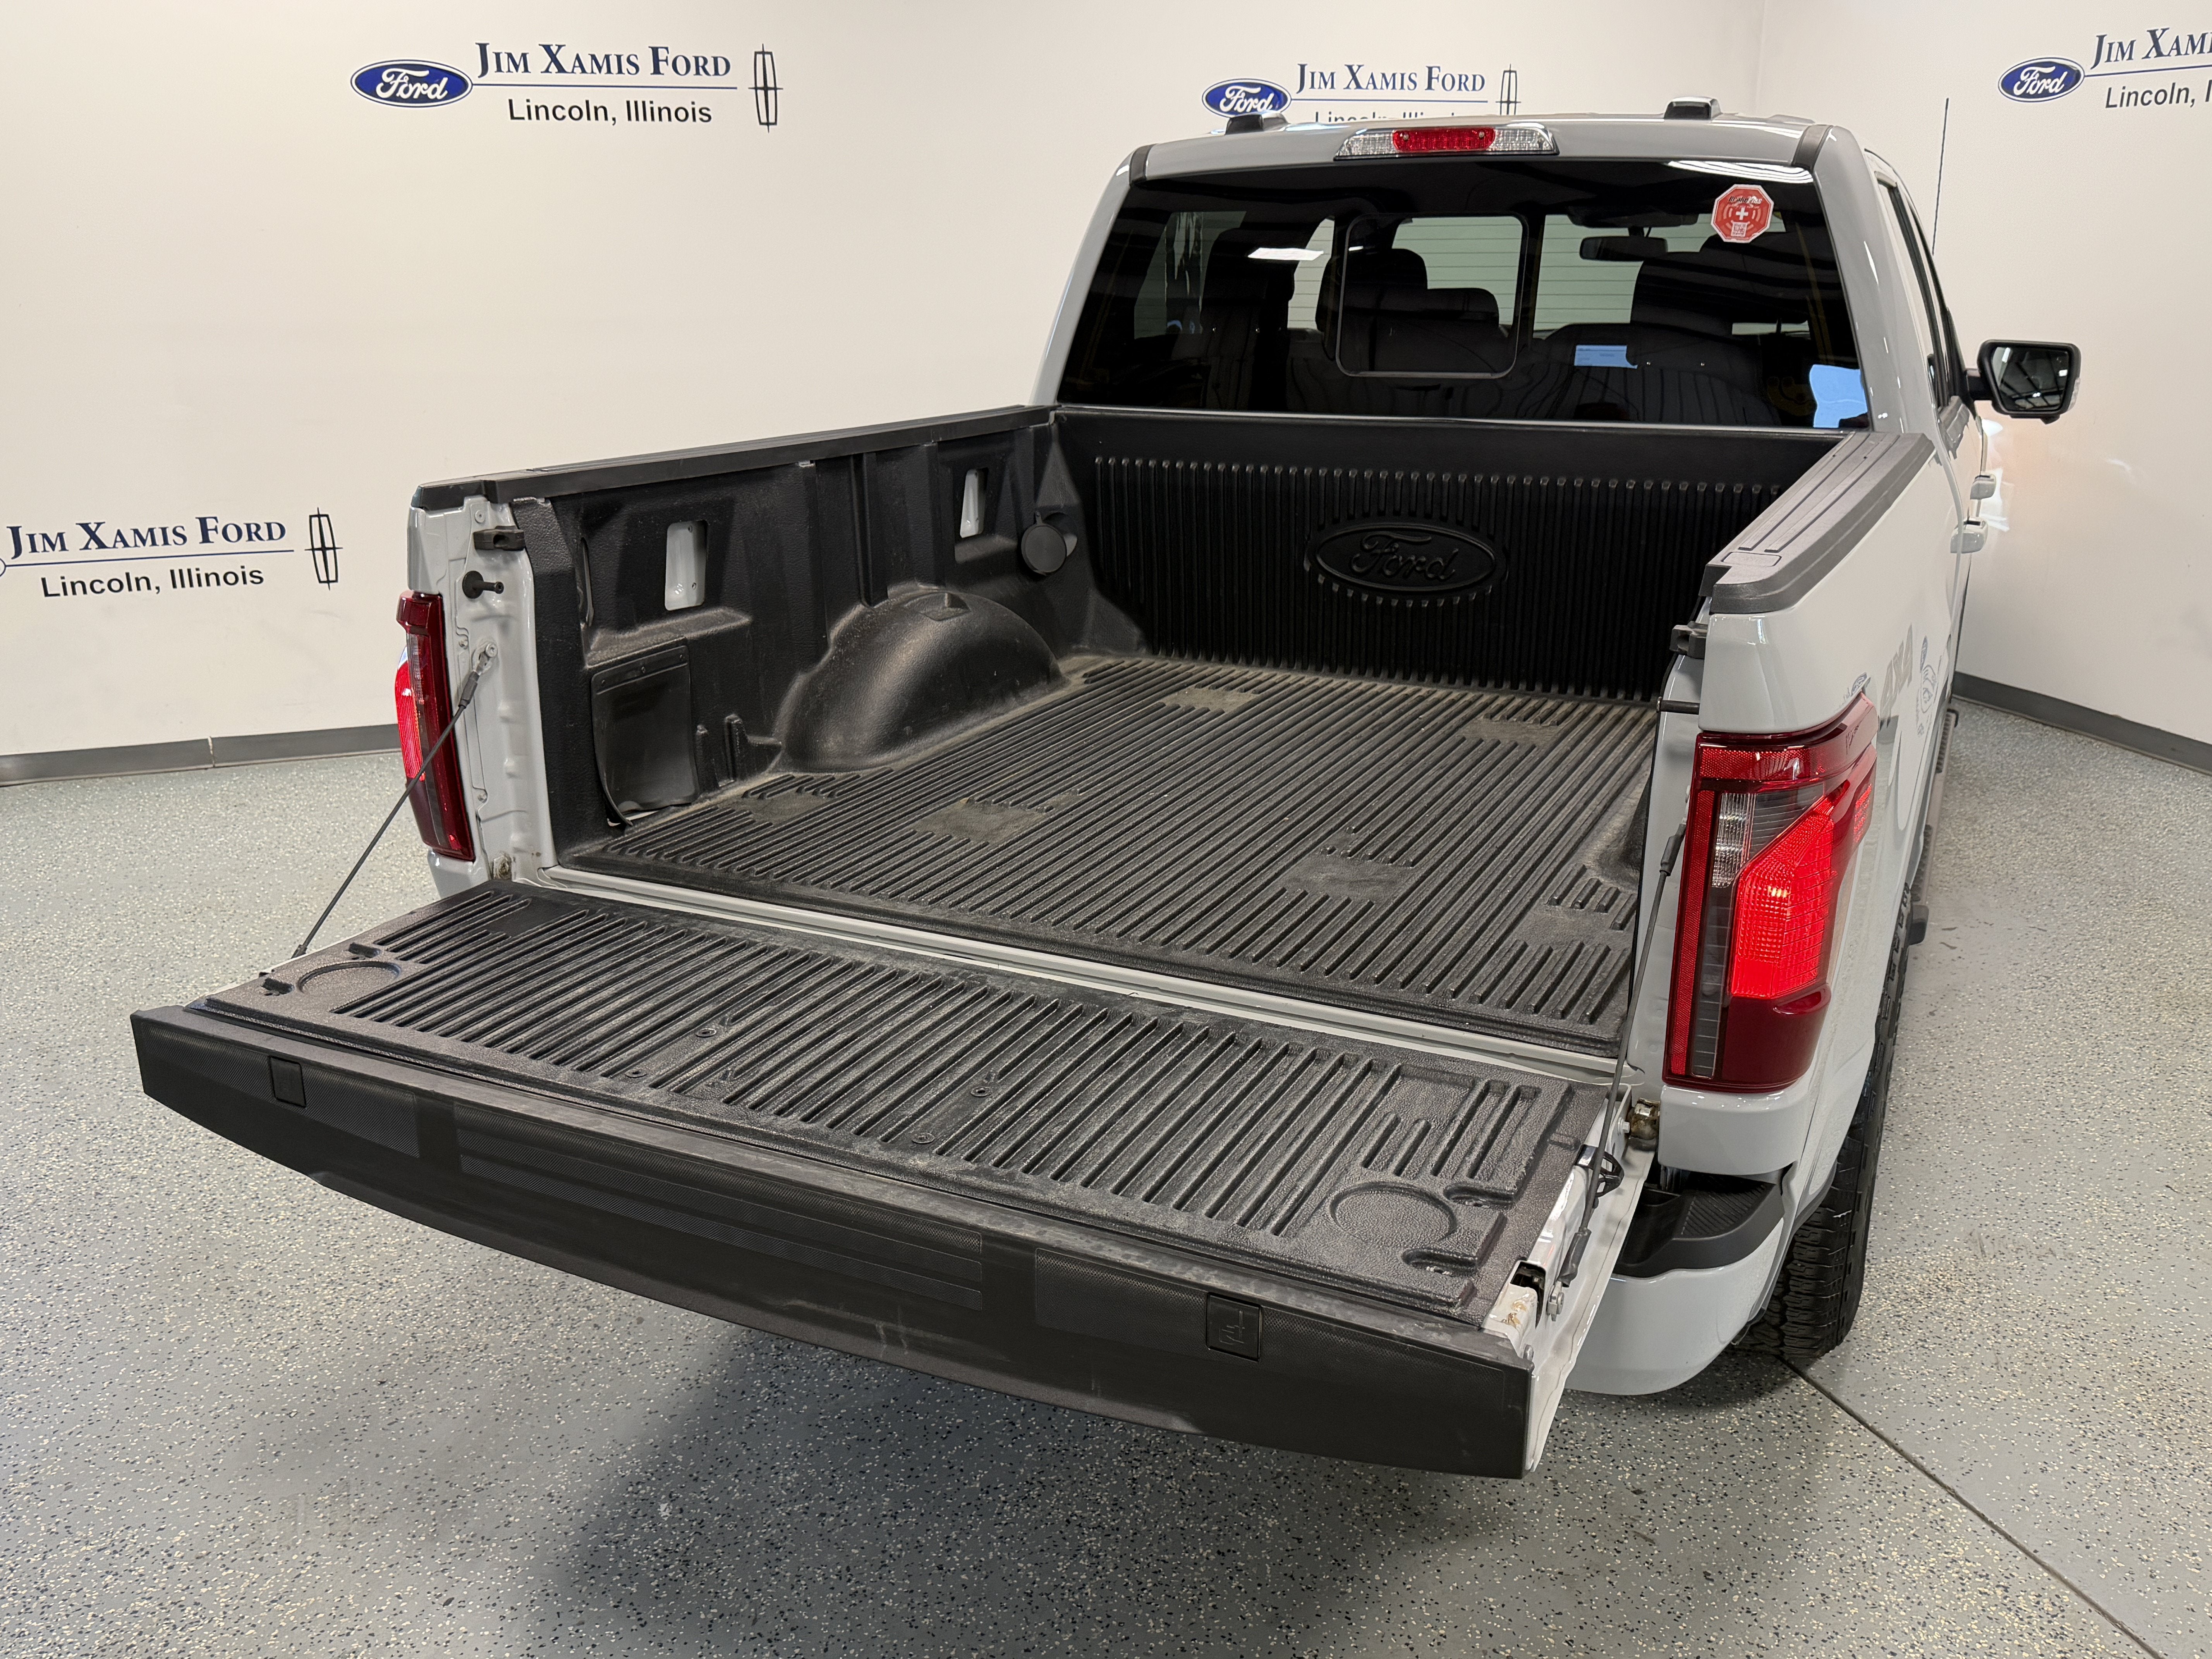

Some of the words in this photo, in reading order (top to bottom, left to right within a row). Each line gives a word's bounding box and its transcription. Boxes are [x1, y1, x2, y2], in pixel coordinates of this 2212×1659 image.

[475, 42, 532, 79] JIM
[538, 43, 640, 76] XAMIS
[648, 45, 731, 77] FORD
[2090, 34, 2137, 70] JIM
[376, 68, 448, 100] Ford
[1296, 63, 1336, 94] JIM
[1343, 64, 1417, 91] XAMIS
[1424, 65, 1486, 92] FORD
[2013, 65, 2068, 96] Ford
[1219, 85, 1274, 112] Ford
[2105, 82, 2195, 109] Lincoln,
[508, 98, 617, 126] Lincoln,
[625, 100, 712, 123] Illinois
[6, 525, 69, 560] JIM
[75, 521, 188, 551] XAMIS
[195, 516, 286, 544] FORD
[1351, 530, 1460, 580] Ford
[41, 572, 160, 598] Lincoln,
[169, 565, 264, 589] Illinois
